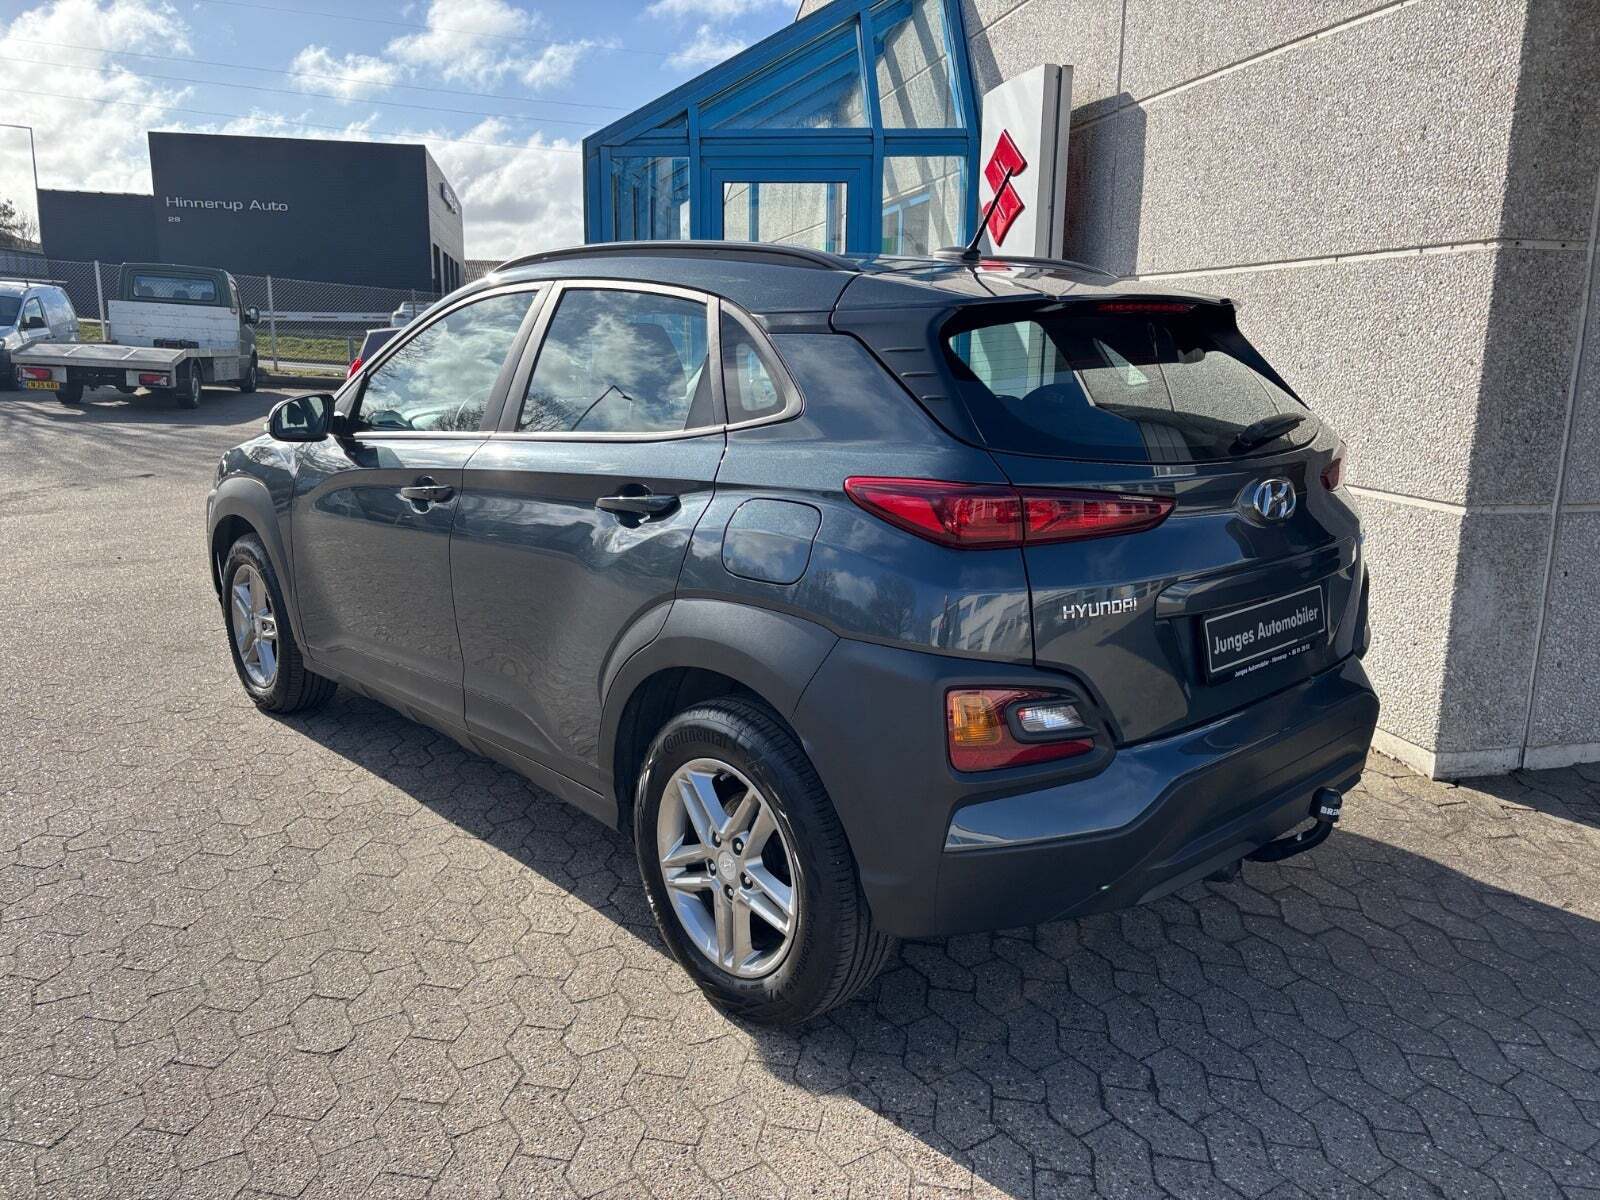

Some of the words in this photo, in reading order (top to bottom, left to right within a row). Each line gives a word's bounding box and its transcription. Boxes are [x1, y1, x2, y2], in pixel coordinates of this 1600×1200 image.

[165, 196, 244, 212] Hinnerup
[248, 199, 289, 212] Auto
[1062, 597, 1137, 620] HYUNDAI
[1213, 629, 1255, 655] Junges
[1257, 605, 1319, 640] Automobiler
